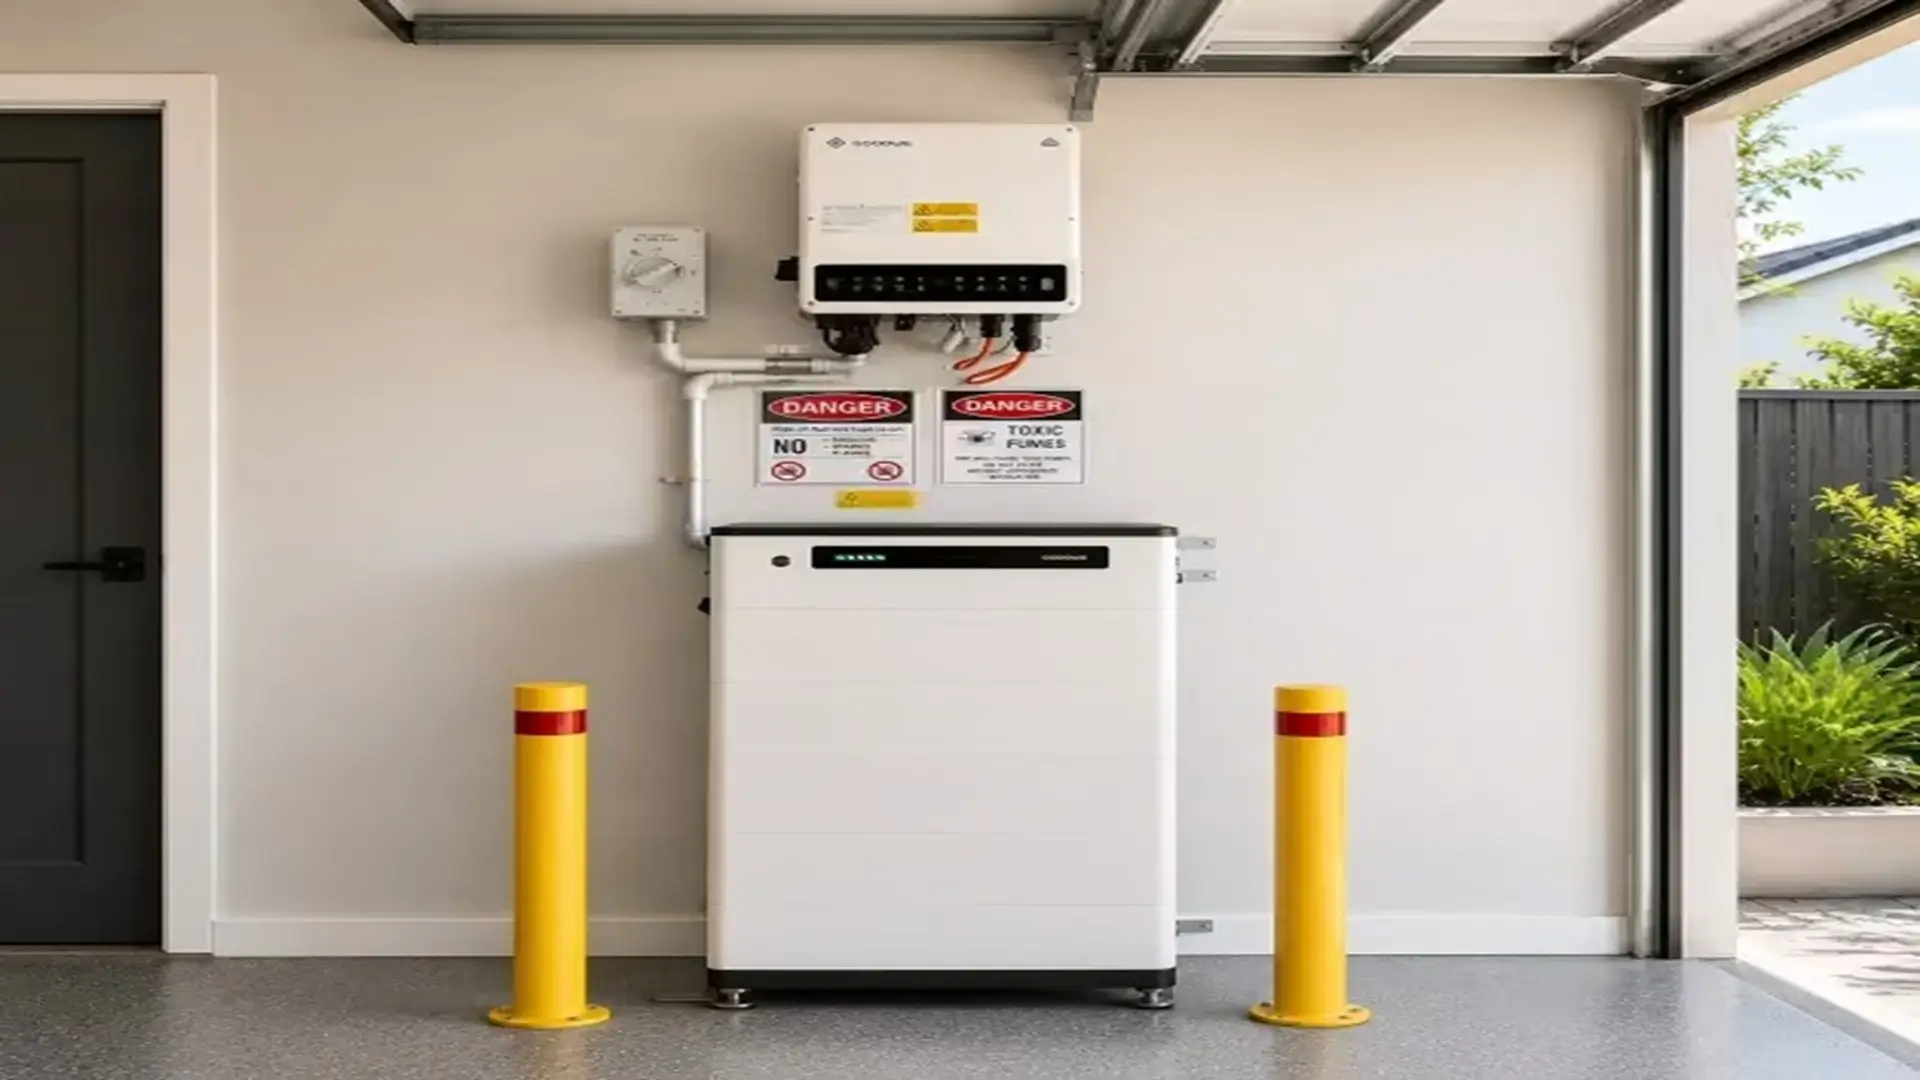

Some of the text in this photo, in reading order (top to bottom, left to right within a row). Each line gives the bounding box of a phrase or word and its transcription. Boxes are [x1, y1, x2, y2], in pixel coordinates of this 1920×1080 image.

[783, 399, 891, 415] DANGER
[966, 399, 1064, 413] DANGER
[1007, 425, 1063, 436] TOXIC
[773, 438, 807, 454] NO
[1006, 439, 1067, 449] FUMES
